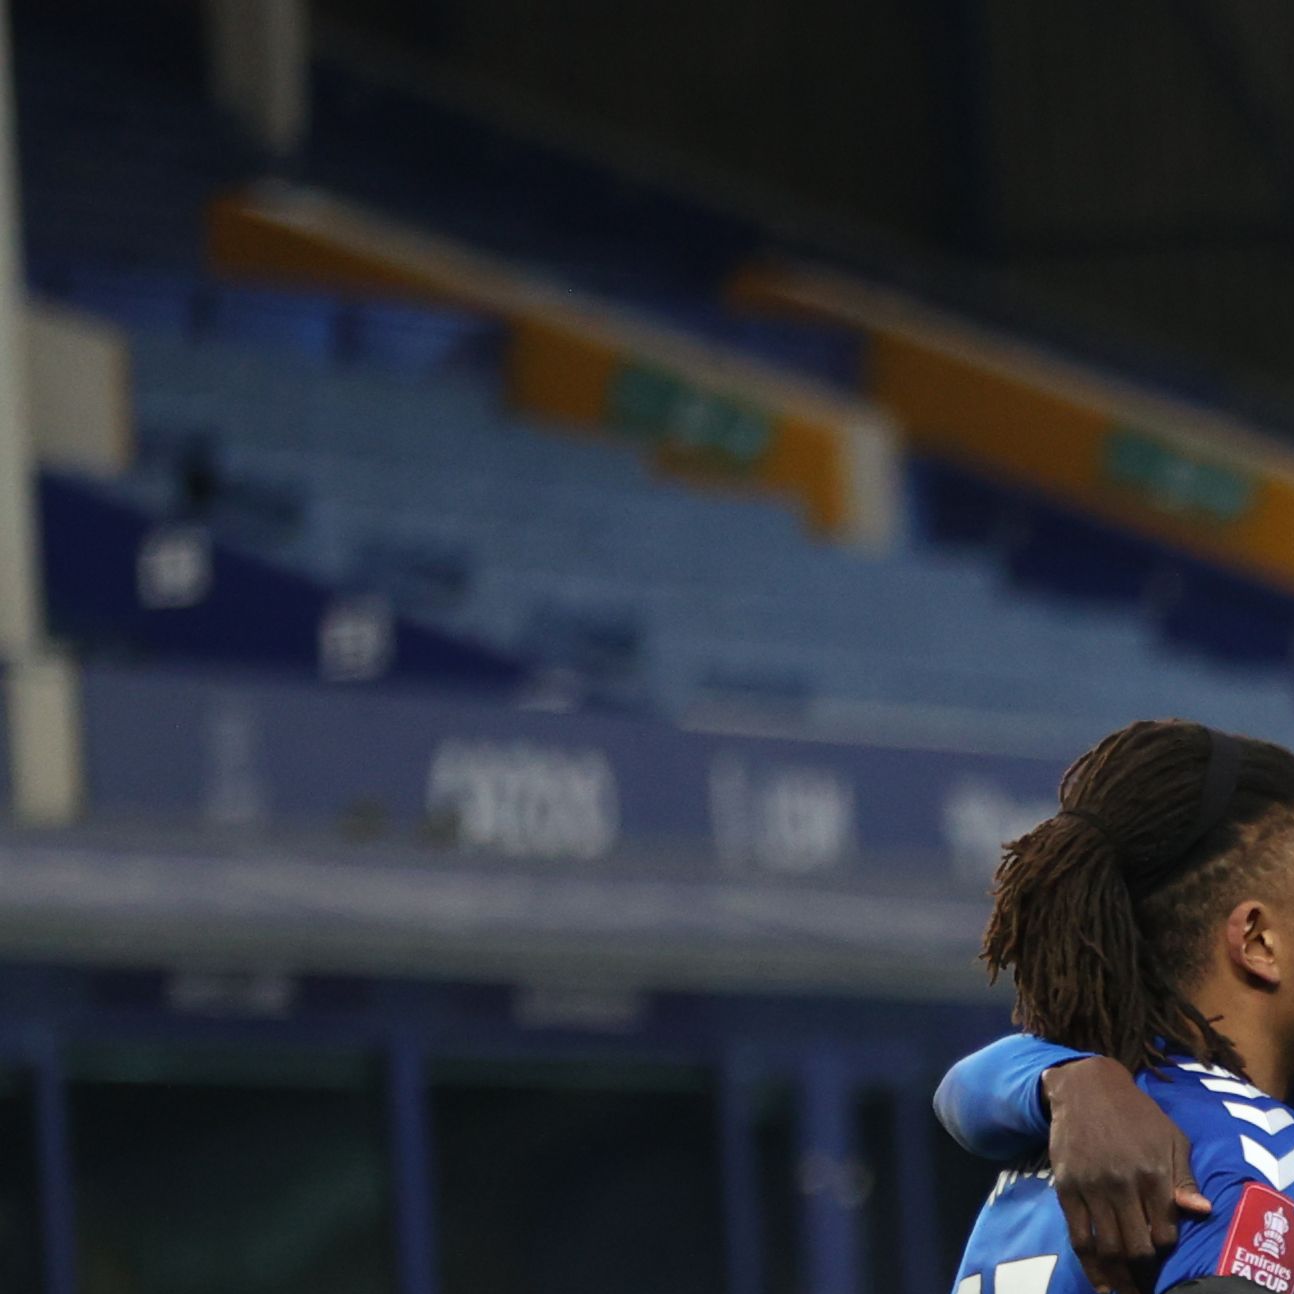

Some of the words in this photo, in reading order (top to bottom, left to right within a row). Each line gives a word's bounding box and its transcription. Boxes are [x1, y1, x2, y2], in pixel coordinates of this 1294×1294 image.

[1231, 1260, 1252, 1281] FA
[1254, 1270, 1289, 1294] CUP
[1235, 1247, 1292, 1281] Emirates
